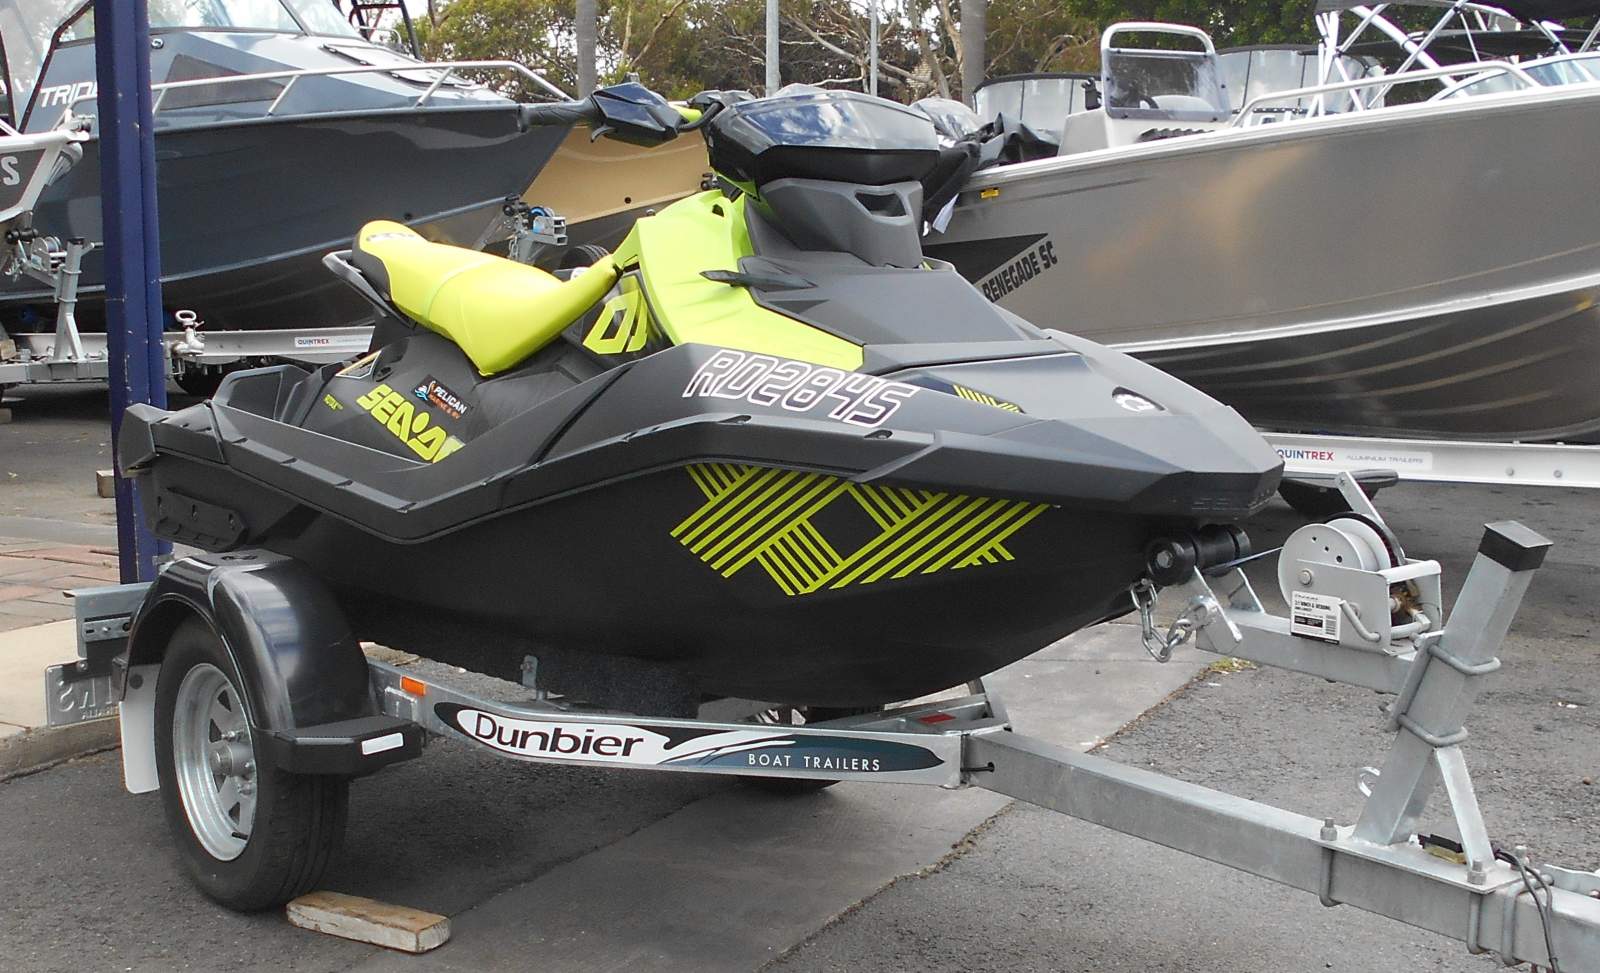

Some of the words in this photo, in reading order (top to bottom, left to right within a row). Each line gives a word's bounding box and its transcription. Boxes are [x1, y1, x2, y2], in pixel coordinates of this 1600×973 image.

[982, 251, 1041, 303] RENEGADE
[1039, 241, 1058, 269] SC
[434, 386, 467, 414] PELICAN
[1276, 449, 1334, 461] QUINTREX
[475, 713, 644, 757] Dunbier
[748, 753, 791, 767] BOAT
[803, 756, 880, 771] TRAILERS
